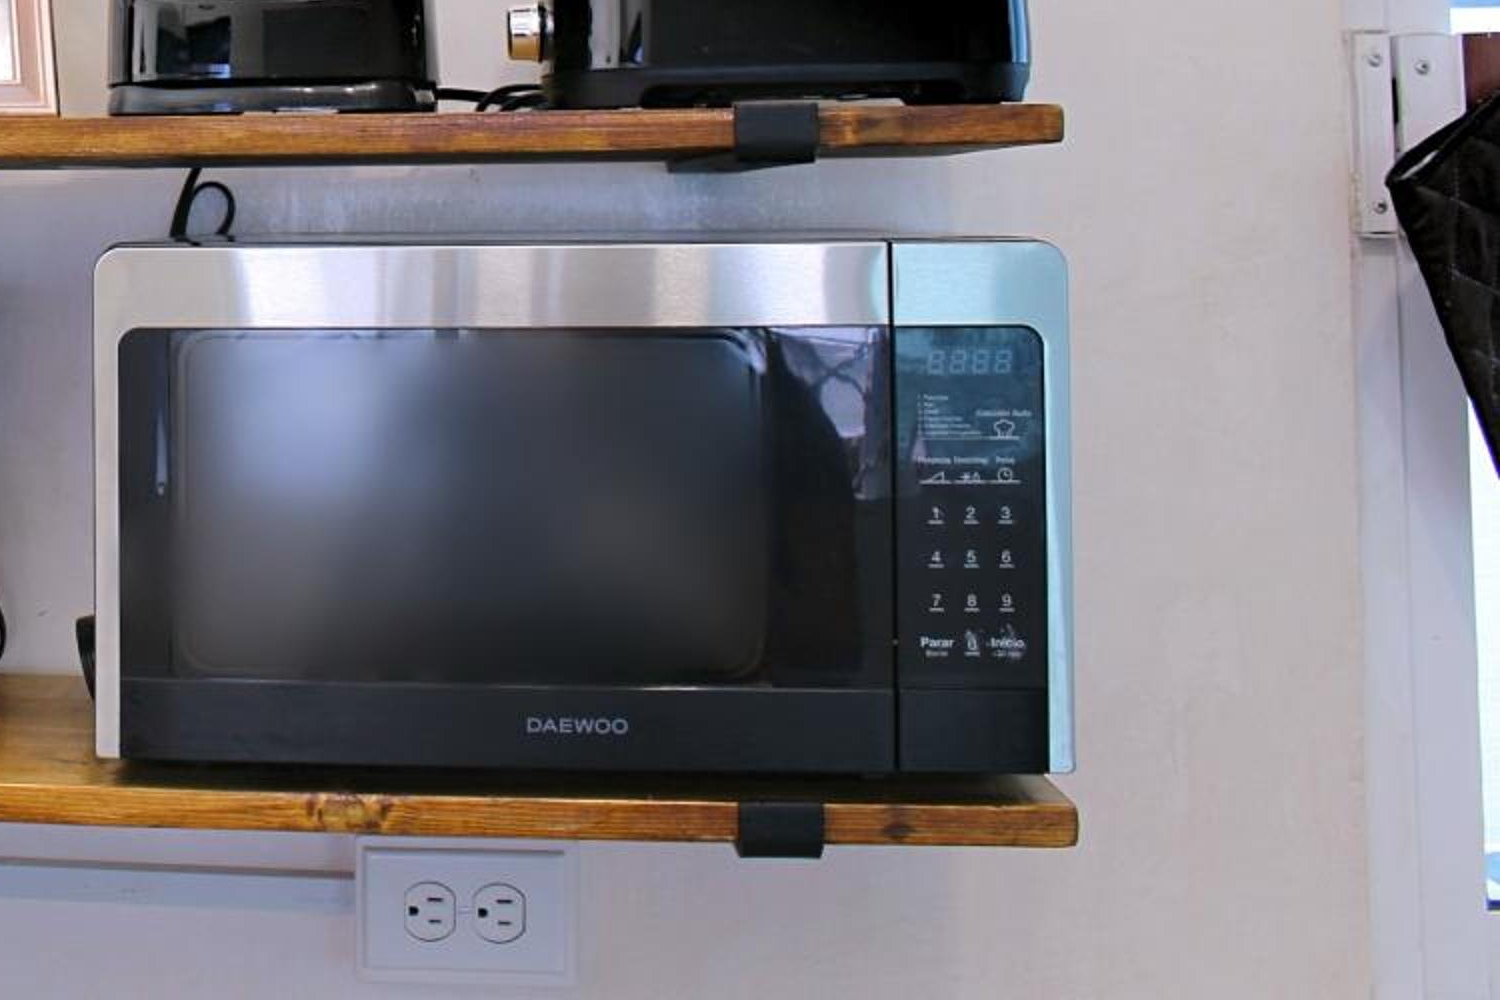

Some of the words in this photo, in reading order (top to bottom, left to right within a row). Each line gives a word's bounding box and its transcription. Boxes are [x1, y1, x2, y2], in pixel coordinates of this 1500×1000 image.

[932, 506, 940, 519] 1
[965, 505, 976, 519] 2
[1000, 505, 1012, 519] 3
[931, 551, 941, 562] 4
[966, 550, 977, 563] 5
[1001, 550, 1012, 563] 6
[932, 593, 942, 607] 7
[966, 593, 977, 607] 8
[1001, 593, 1012, 607] 9
[920, 635, 955, 648] Parar
[526, 717, 629, 734] DAEWOO
